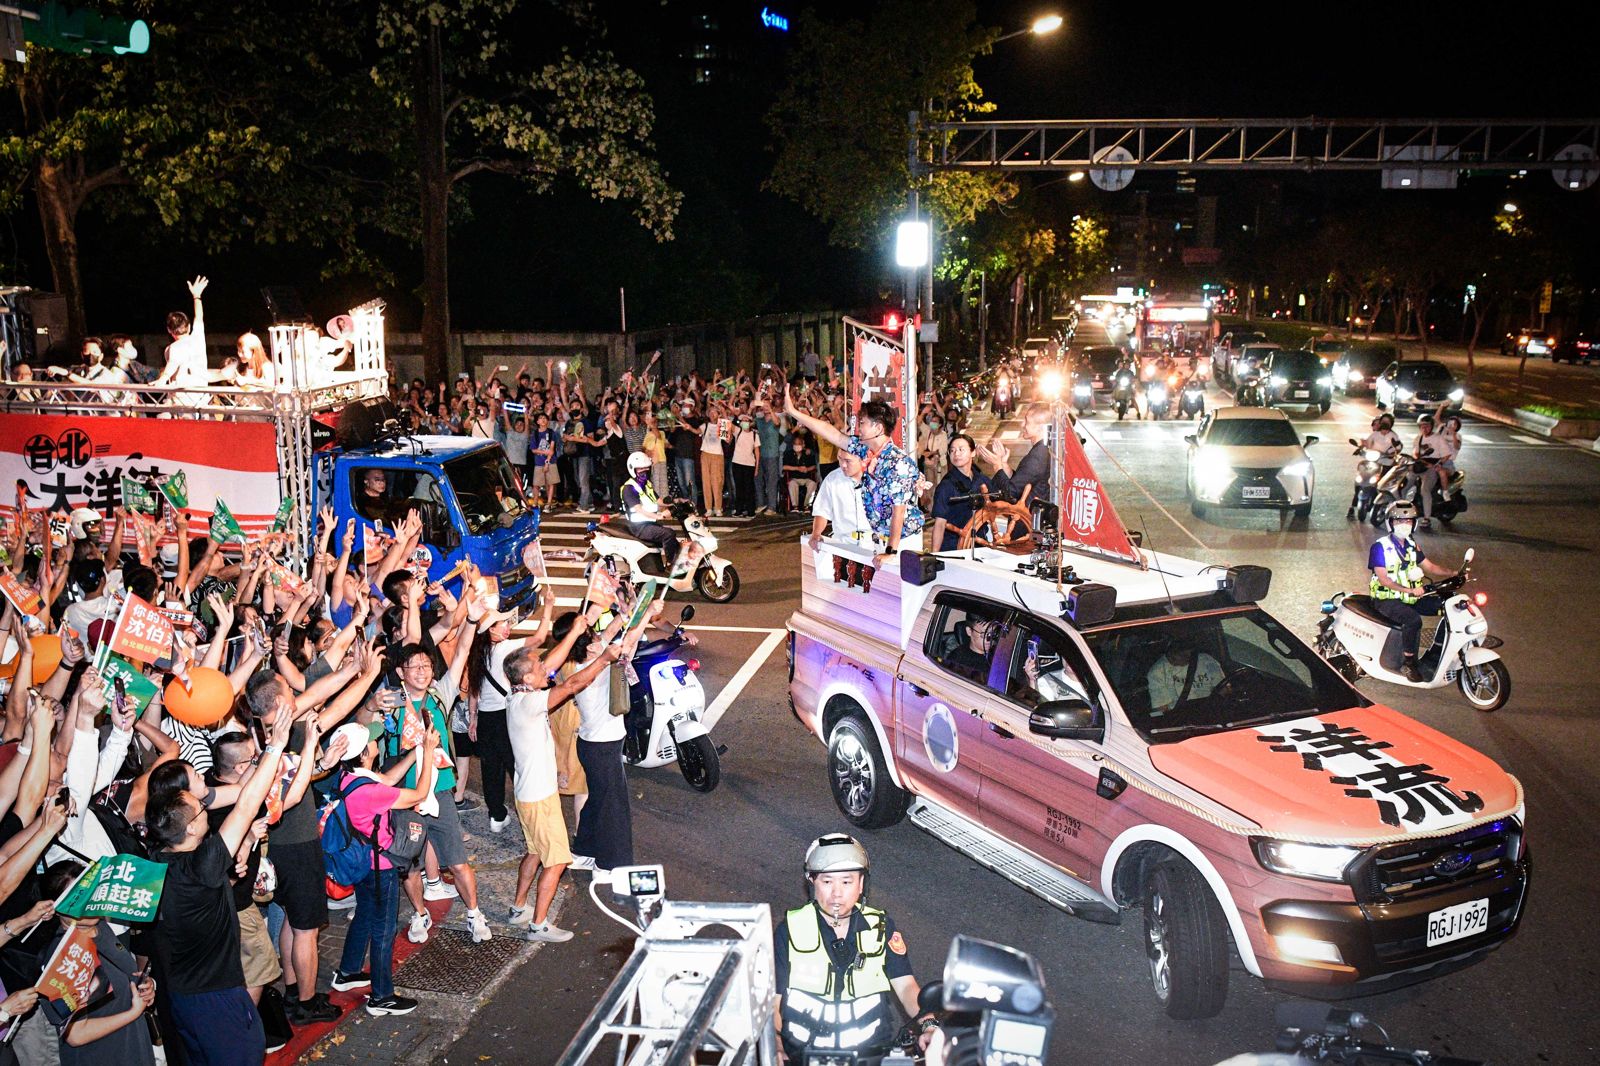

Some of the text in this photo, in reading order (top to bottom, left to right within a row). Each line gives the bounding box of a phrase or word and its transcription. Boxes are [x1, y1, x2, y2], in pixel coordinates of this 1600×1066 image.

[25, 429, 91, 472] 台北
[1070, 486, 1098, 533] 順
[1256, 723, 1485, 828] 洋流
[1046, 806, 1081, 831] RGJ-1992
[99, 861, 136, 882] 台北
[90, 882, 153, 909] 順起來
[85, 903, 149, 918] FUTURE SOON
